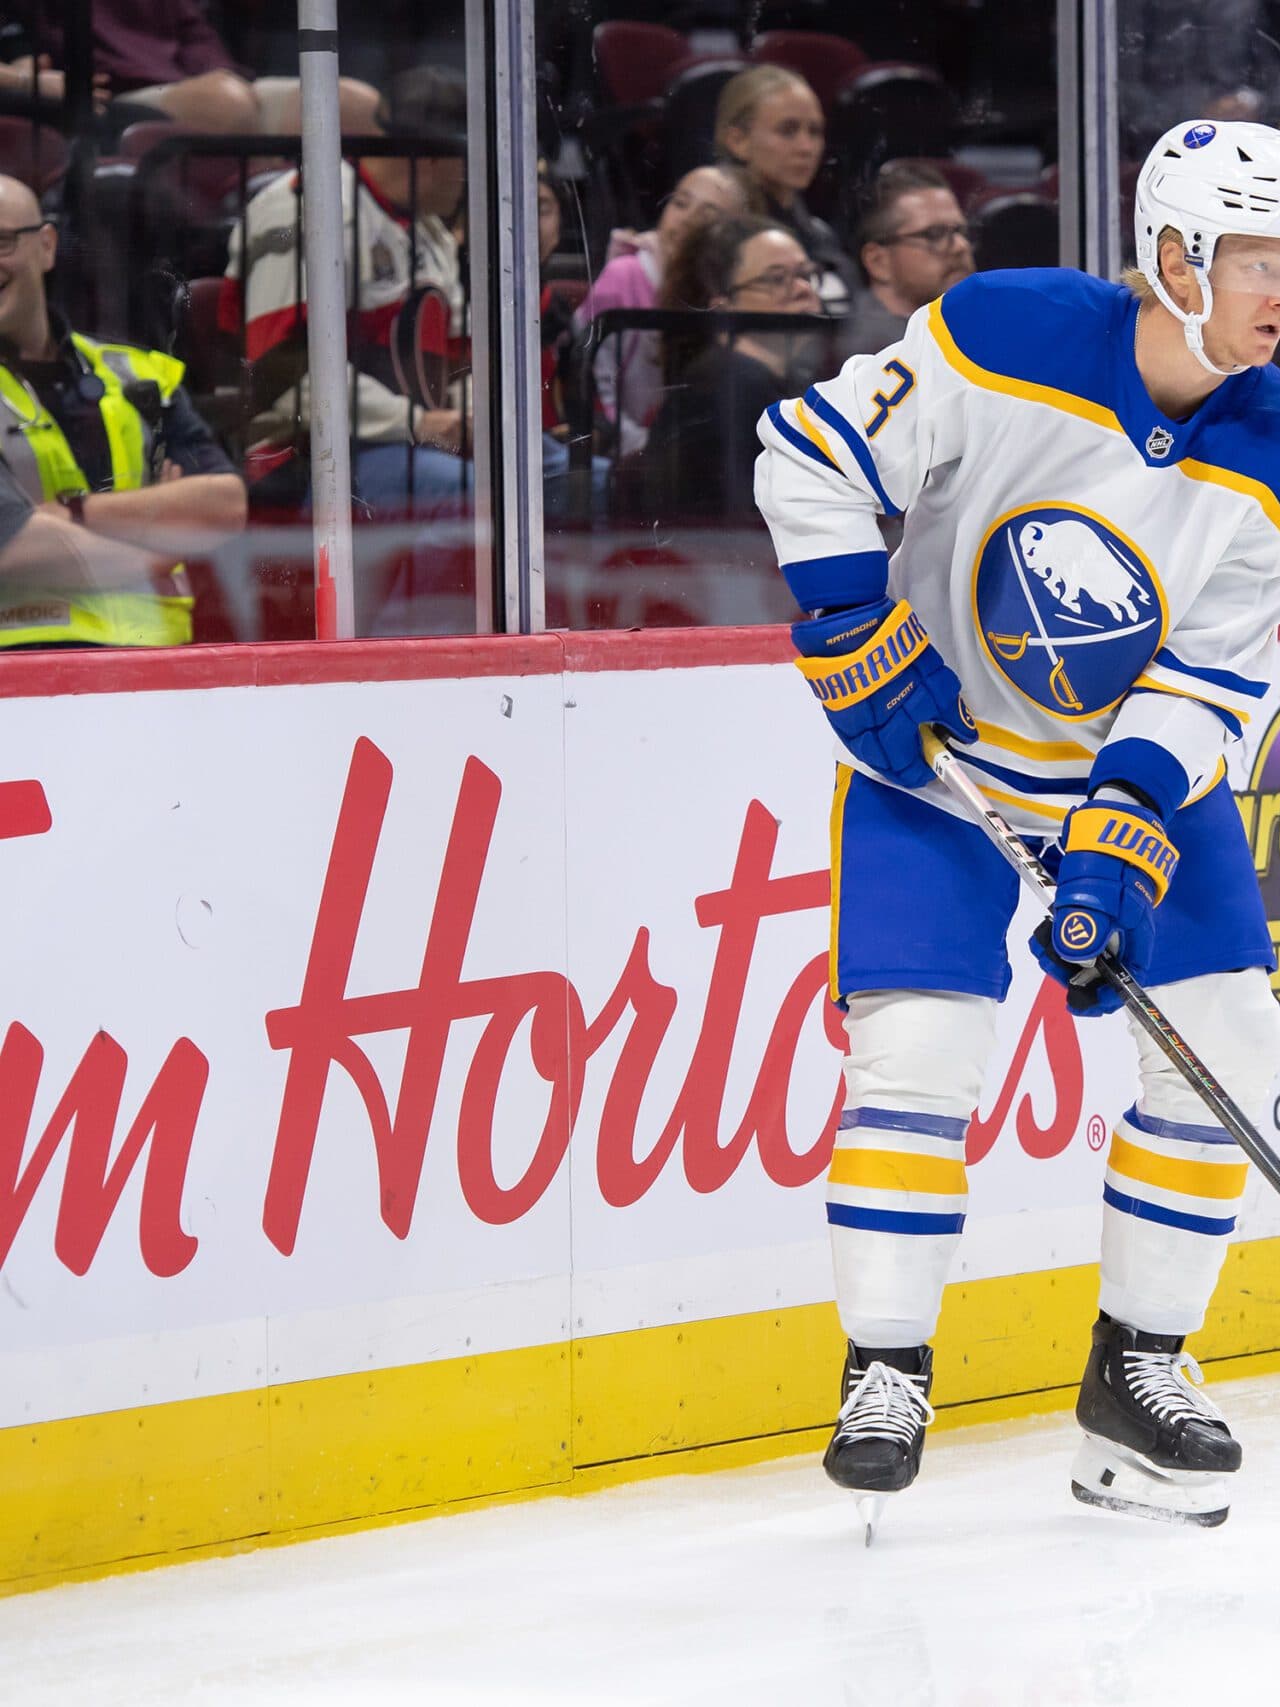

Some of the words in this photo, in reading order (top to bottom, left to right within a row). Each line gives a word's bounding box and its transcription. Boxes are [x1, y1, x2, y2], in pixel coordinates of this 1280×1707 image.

[864, 358, 917, 440] 3
[1134, 881, 1152, 902] COVER
[263, 736, 1083, 1256] Hortos
